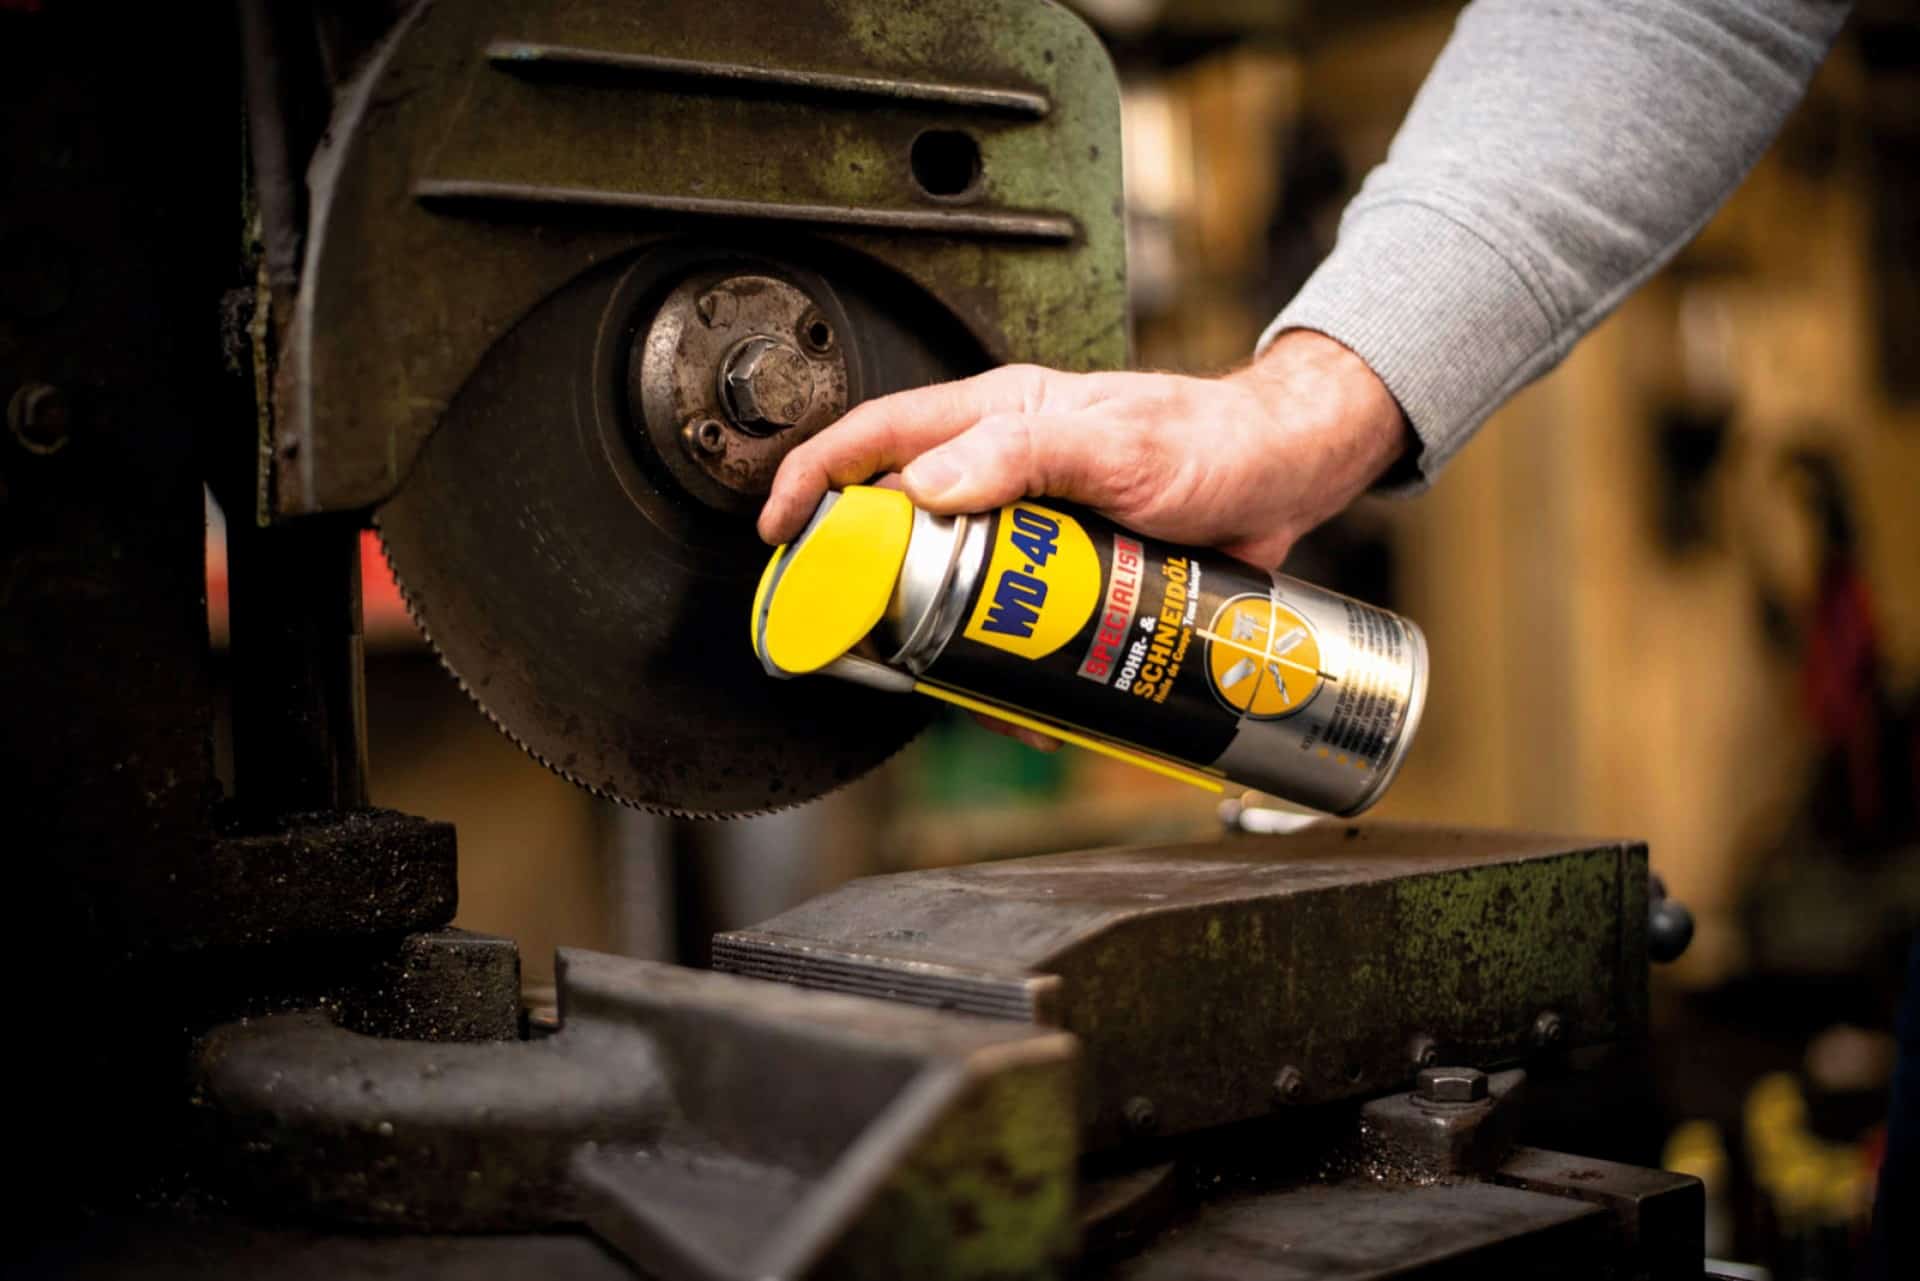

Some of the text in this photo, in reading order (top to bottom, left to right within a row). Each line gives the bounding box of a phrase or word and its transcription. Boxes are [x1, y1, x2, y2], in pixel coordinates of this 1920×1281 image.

[982, 508, 1060, 638] WD-40
[1133, 557, 1187, 699] SCHNEIDÖL
[1115, 616, 1156, 691] BOHR- &
